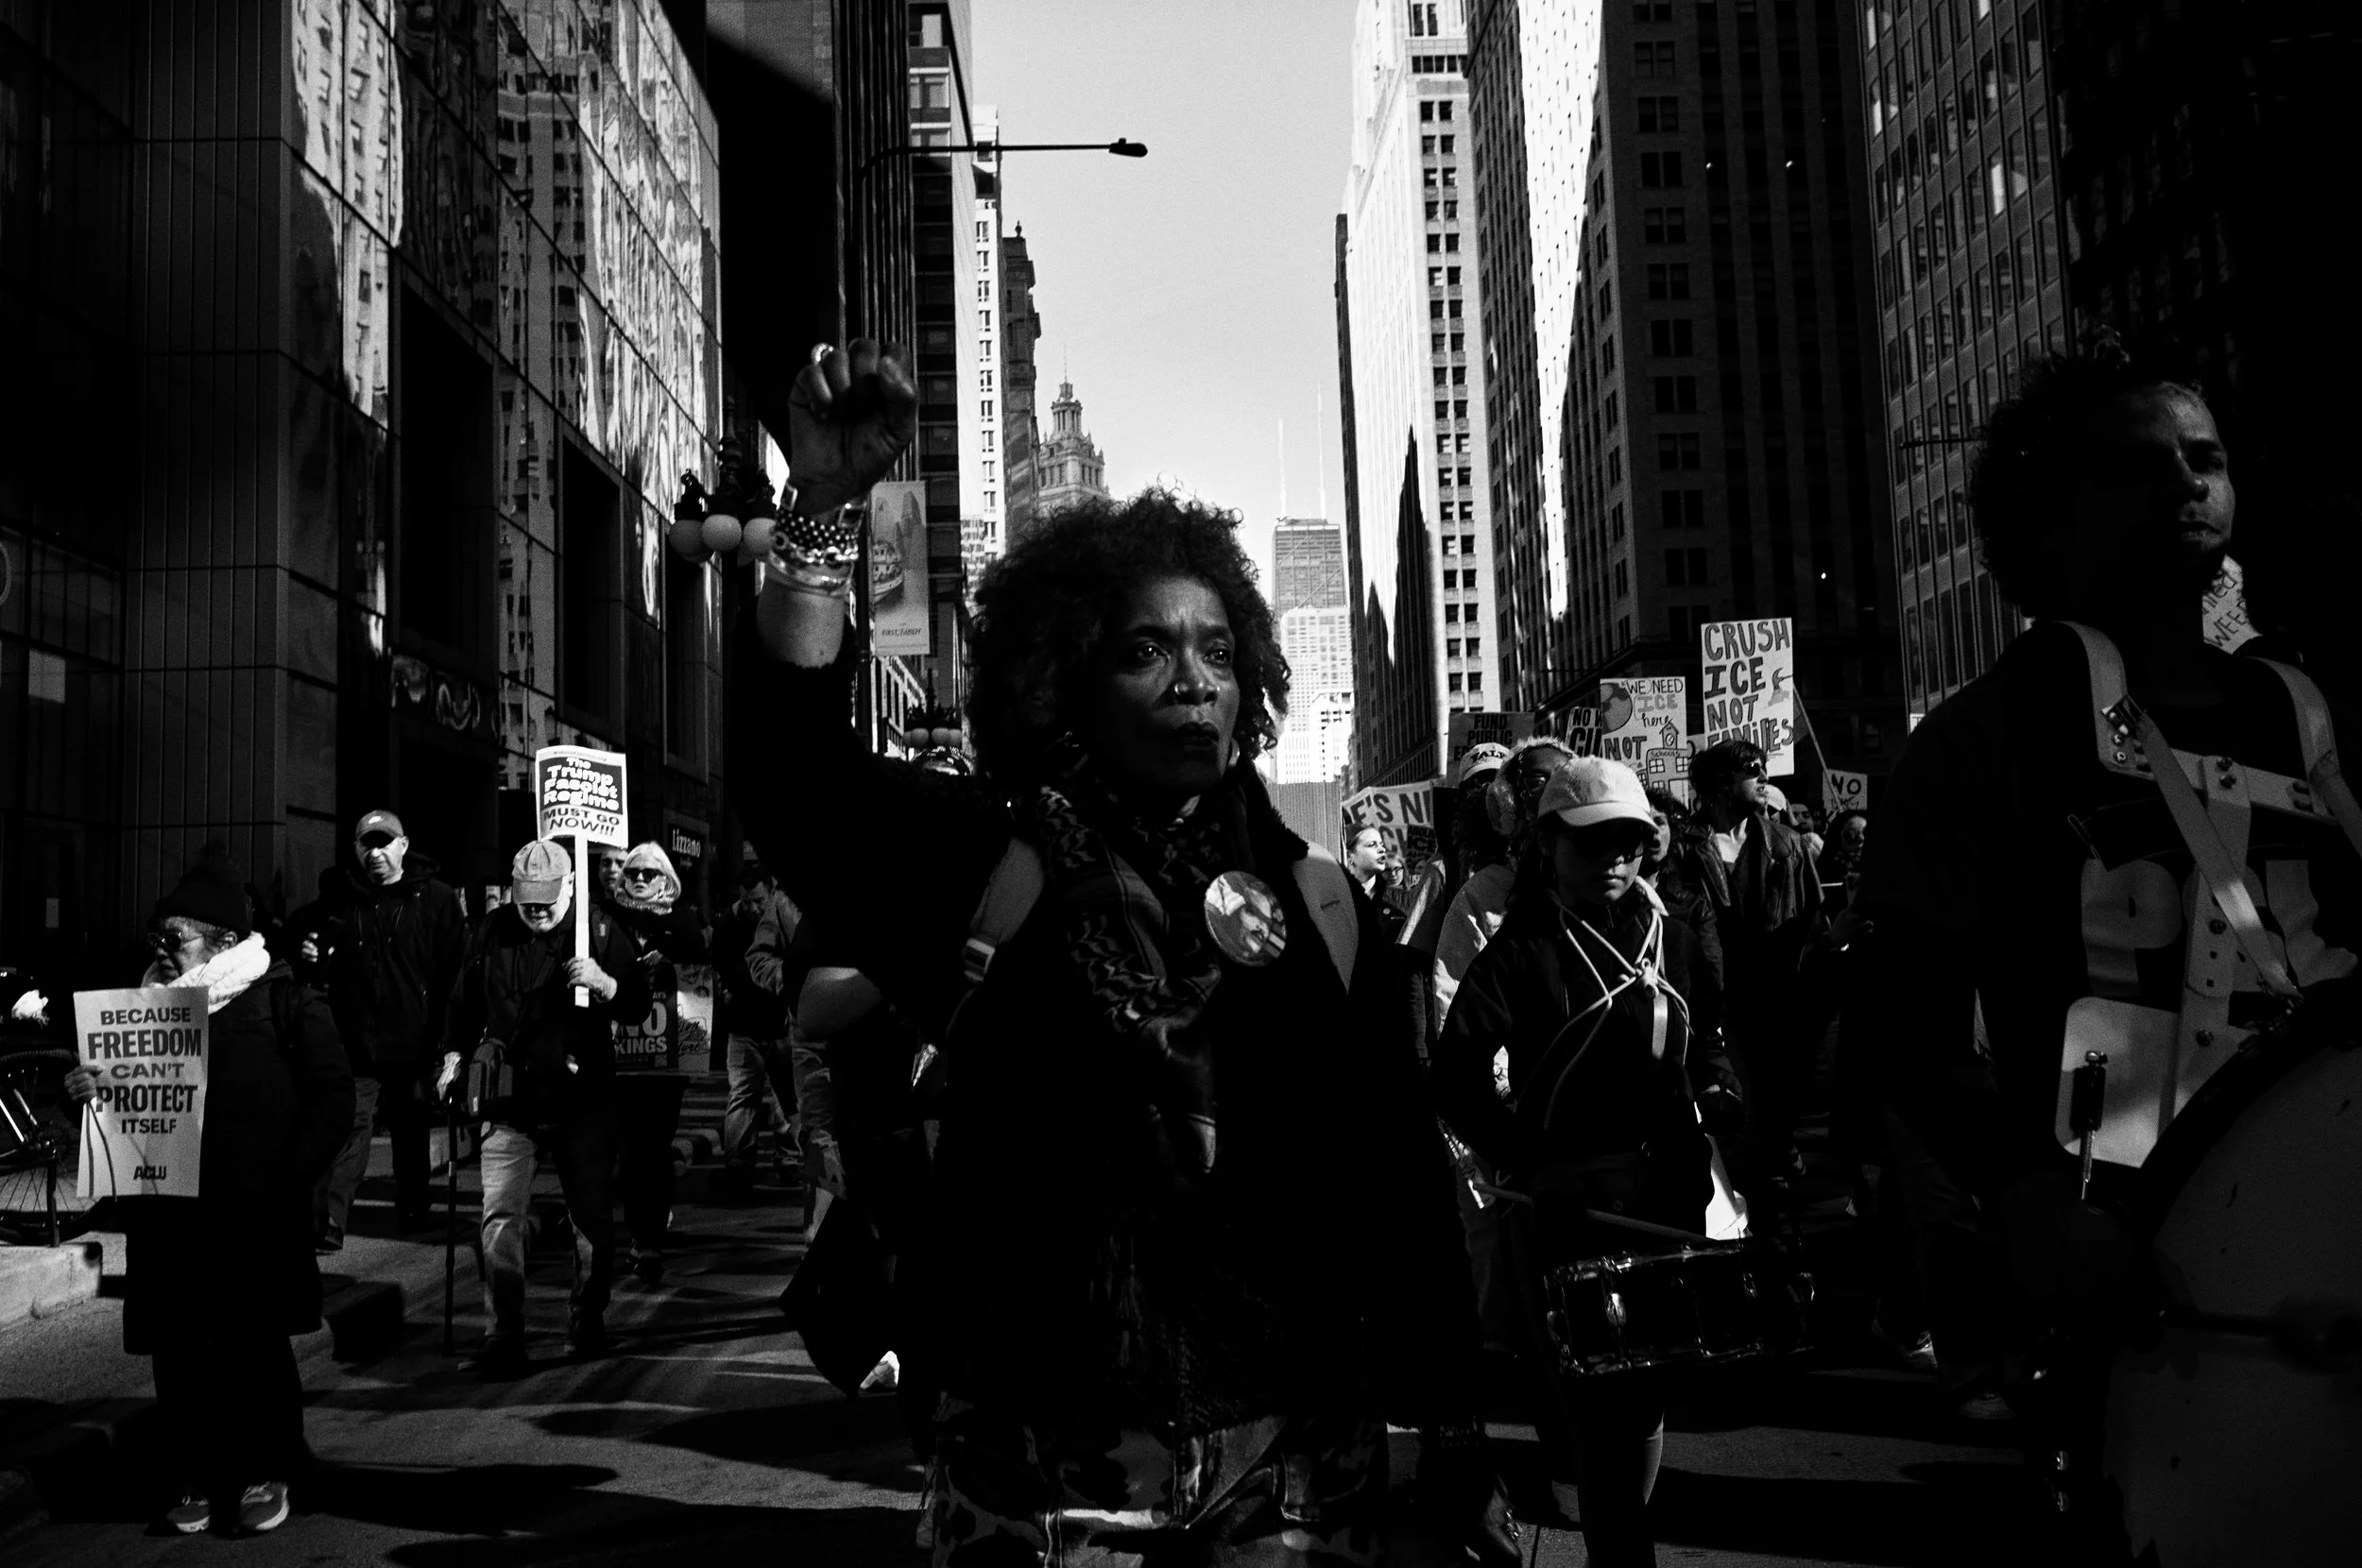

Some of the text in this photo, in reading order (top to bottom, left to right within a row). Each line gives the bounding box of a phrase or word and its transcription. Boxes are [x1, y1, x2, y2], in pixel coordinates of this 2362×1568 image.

[1704, 619, 1789, 661] CRUSH
[1652, 678, 1683, 694] NEED
[1704, 656, 1766, 699] ICE
[1637, 694, 1678, 712] ICE
[1706, 693, 1759, 732] NOT
[1474, 713, 1508, 729] FUND
[1572, 708, 1591, 726] NO
[1641, 712, 1669, 728] here
[1467, 730, 1514, 745] PUBLIC
[1604, 736, 1647, 761] NOT
[566, 757, 591, 769] The
[547, 765, 613, 786] Trump
[1831, 774, 1861, 794] NO
[544, 777, 618, 798] Fascist
[543, 790, 620, 810] Regime
[543, 808, 620, 826] MUST GO
[550, 817, 615, 836] NOW!!!
[100, 1007, 191, 1026] BECAUSE
[617, 1001, 667, 1037] O
[87, 1028, 201, 1060] FREEDOM
[614, 1036, 668, 1054] KINGS
[111, 1063, 185, 1079] CAN'T
[95, 1084, 198, 1113] PROTECT
[121, 1118, 178, 1134] ITSELF
[133, 1166, 167, 1180] ACLU
